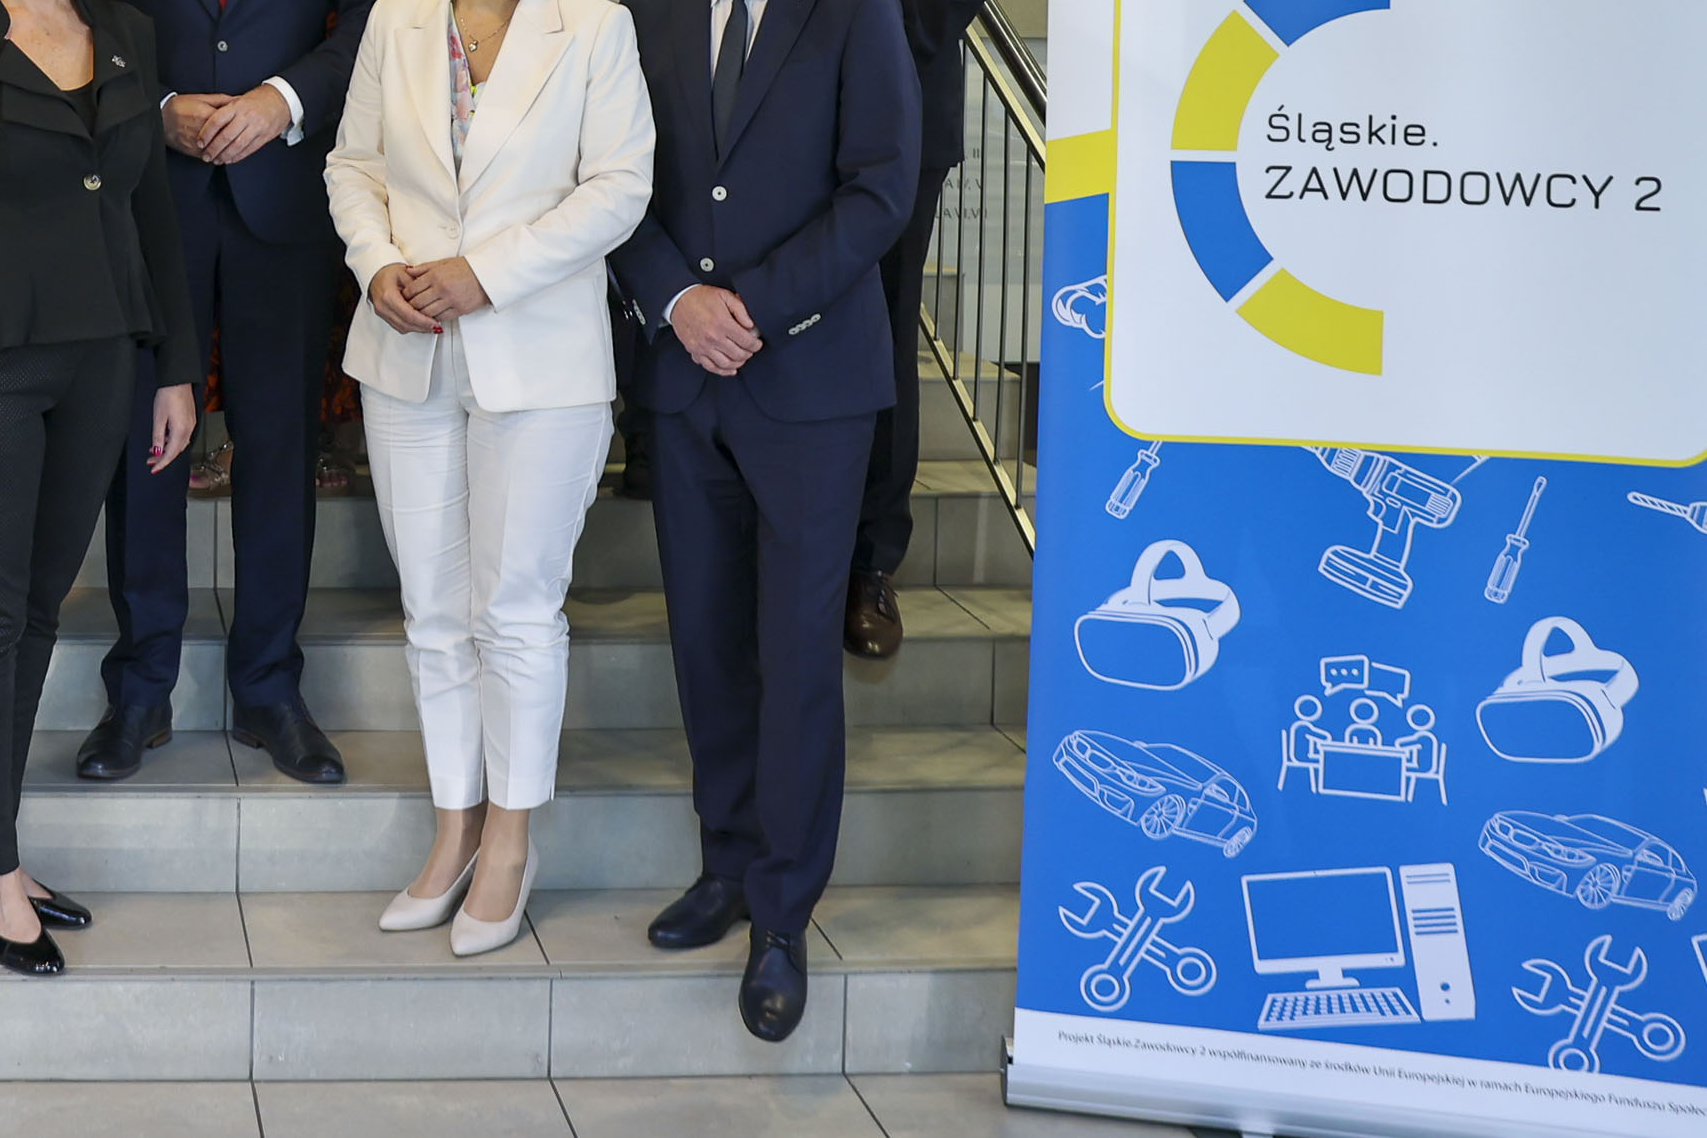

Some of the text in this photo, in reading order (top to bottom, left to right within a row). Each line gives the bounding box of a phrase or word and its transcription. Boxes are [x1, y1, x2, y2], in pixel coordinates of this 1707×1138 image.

[1266, 104, 1439, 152] Śląskie.
[1264, 165, 1663, 212] ZAWODOWCY 2
[1057, 1029, 1094, 1046] Projekt
[1309, 1060, 1322, 1069] ze
[1373, 1065, 1396, 1079] Unii
[1398, 1067, 1465, 1088] Europejskiej
[1480, 1078, 1522, 1094] ramach
[1524, 1083, 1606, 1105] Europejskiego
